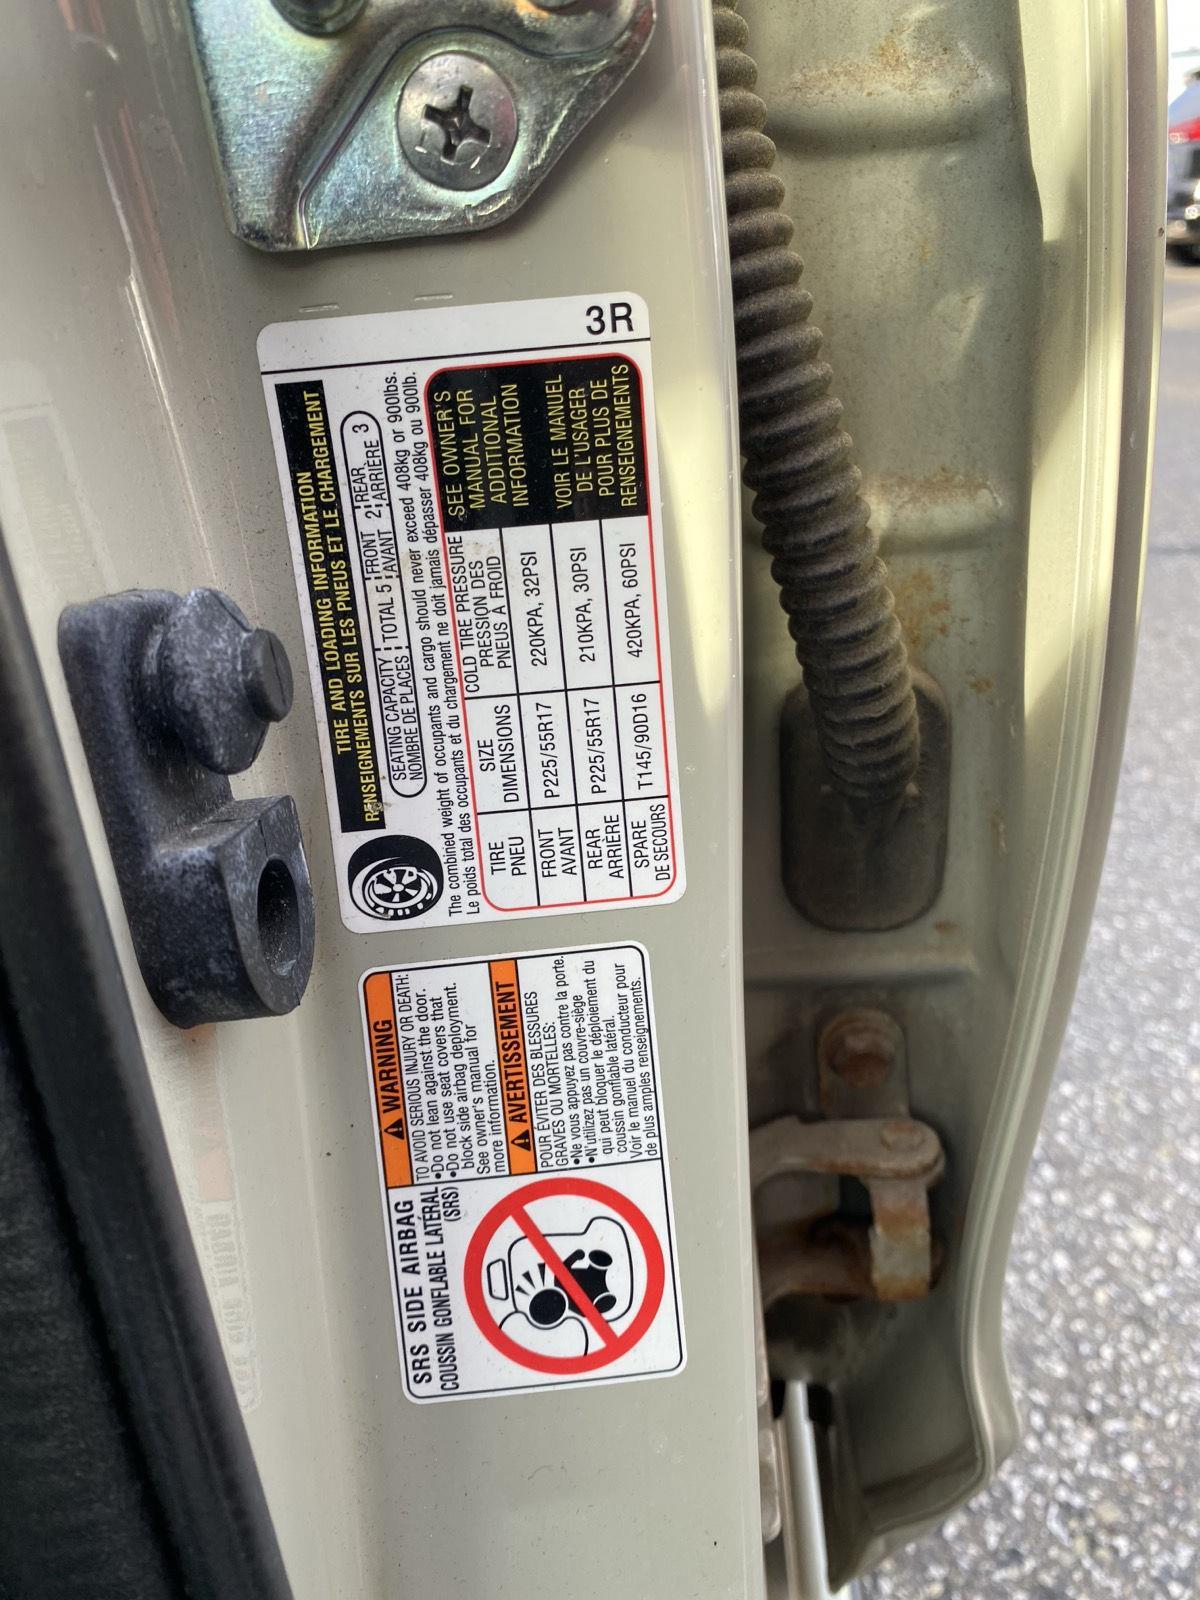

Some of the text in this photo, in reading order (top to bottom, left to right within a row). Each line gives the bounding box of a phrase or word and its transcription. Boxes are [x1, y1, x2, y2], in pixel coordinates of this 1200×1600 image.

[586, 302, 633, 335] 3R
[350, 467, 369, 502] REAR
[351, 423, 369, 433] 3
[363, 440, 387, 501] ARRIÈRE
[433, 390, 464, 518] SEE OWNER'S
[456, 389, 485, 508] MANUAL FOR
[479, 395, 506, 504] ADDITIONAL
[500, 384, 528, 505] INFORMATION
[545, 374, 572, 508] VOIR LE MANUEL
[568, 388, 592, 491] DE L'USAGER
[590, 379, 614, 495] POUR PLUS DE
[611, 364, 637, 505] RENSEIGNEMENTS
[303, 390, 362, 682] SUR LES PNEUS ET LE CHARGEMENT
[360, 530, 380, 573] FRONT
[364, 509, 381, 518] 2
[377, 528, 397, 572] AVANT
[296, 472, 352, 754] TIRE AND LOADING INFORMATION
[375, 584, 398, 642] TOTAL 5
[381, 372, 463, 915] The combined weight occupants and cargo should never exceed 408kg 900lbs.
[401, 372, 482, 914] Le poids total des occupants chargement ne doit jamais dépasser 408kg ou 900lb.
[447, 535, 479, 692] COLD TIRE PRESSURE
[468, 560, 493, 666] PRESSION DES
[485, 555, 511, 668] PNEUS À FROID
[520, 551, 548, 666] 220KPA, 32PSI
[569, 547, 596, 662] 210KPA, 30PSI
[619, 543, 645, 657] 420KPA, 60PSI
[377, 656, 406, 780] SEATING CAPACITY
[394, 655, 423, 779] NOMBRE DE PLACES
[477, 739, 495, 771] SIZE
[494, 704, 518, 802] DIMENSIONS
[535, 701, 560, 797] P225/55R17
[583, 697, 607, 793] P225/55R17
[631, 693, 654, 789] T145/90D16
[488, 841, 506, 874] TIRE
[508, 836, 526, 875] PNEU
[538, 828, 556, 877] FRONT
[558, 826, 576, 875] AVANT
[585, 828, 602, 868] REAR
[603, 814, 623, 879] ARRIÈRE
[631, 820, 649, 868] SPARE
[650, 803, 670, 880] DE SECOURS
[372, 1019, 400, 1113] WARNING
[395, 974, 428, 1163] AVOID SERIOUS INJURY DEATH:
[412, 988, 442, 1149] not lean against the door.
[428, 996, 457, 1148] not use seat covers that
[442, 982, 474, 1168] block side airbag deployment.
[462, 1023, 490, 1174] See owner's manual for
[495, 980, 526, 1124] AVERTISSEMENT
[524, 991, 553, 1167] POUR ÉVITER DES BLESSURES
[542, 1021, 568, 1165] GRAVES MORTELLES:
[551, 953, 581, 1139] vous appuyez pas contre porte.
[570, 994, 596, 1104] pas couvre-siège
[583, 977, 613, 1133] peut bloquer déploiement
[602, 1015, 627, 1153] coussin gonflable latéral.
[614, 962, 642, 1158] Voir manuel conducteur pour
[629, 977, 658, 1138] plus amples renseignements.
[482, 1059, 505, 1172] more information.
[441, 1186, 461, 1222] (SRS)
[394, 1200, 432, 1384] SRS SIDE AIRBAG
[418, 1186, 459, 1390] COUSSIN GONFLABLE LATÉRAL
